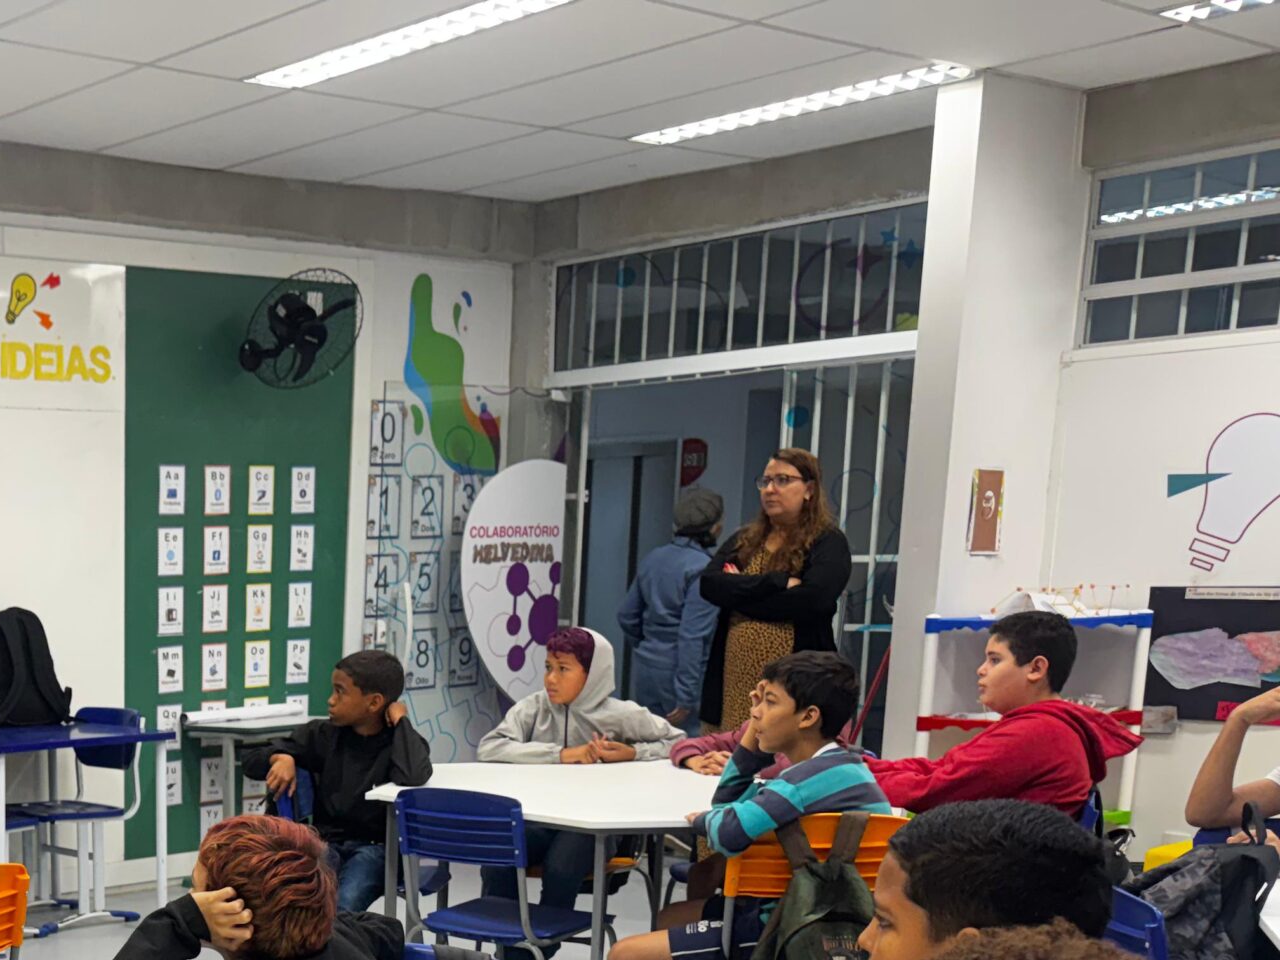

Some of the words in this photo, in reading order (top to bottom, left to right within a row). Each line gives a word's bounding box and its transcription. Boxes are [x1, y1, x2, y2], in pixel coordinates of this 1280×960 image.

[381, 412, 395, 443] 0
[380, 486, 388, 516] 1
[420, 486, 434, 516] 2
[470, 524, 560, 538] COLABORATÓRIO
[374, 565, 389, 594] 4
[418, 563, 431, 592] 5
[416, 640, 429, 668] 8
[459, 637, 472, 665] 9
